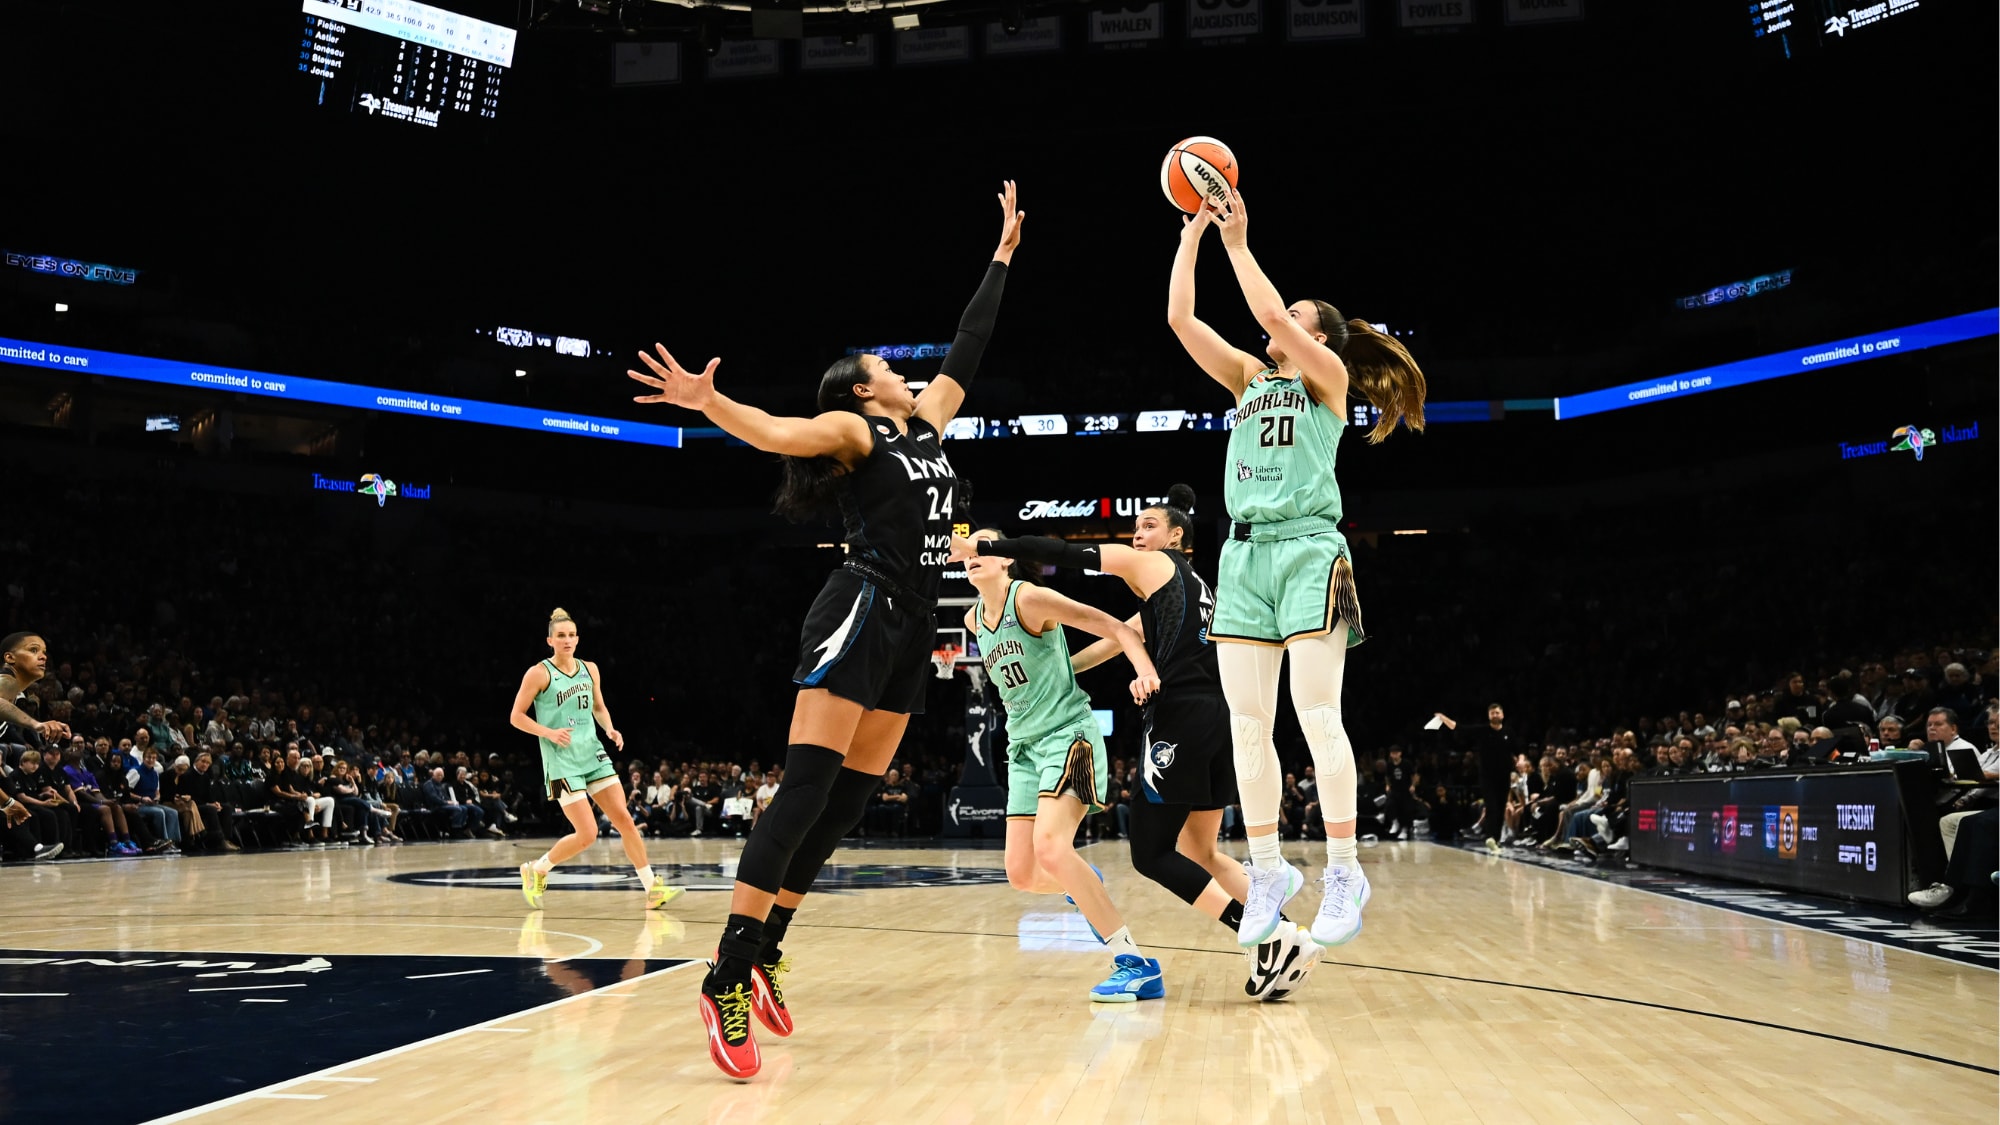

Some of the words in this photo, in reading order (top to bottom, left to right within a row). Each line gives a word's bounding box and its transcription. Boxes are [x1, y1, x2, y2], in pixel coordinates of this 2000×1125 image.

[1192, 13, 1257, 29] AUGUSTUS
[1294, 10, 1358, 27] BRUNSON
[1409, 2, 1463, 18] FOWLES
[1763, 3, 1794, 21] Stewart
[1848, 2, 1887, 23] Treasure
[1101, 18, 1152, 33] WHALEN
[1767, 19, 1792, 33] Jones
[306, 16, 315, 25] 13
[317, 19, 346, 34] Fiebich
[400, 41, 406, 49] 2
[416, 46, 422, 54] 2
[432, 49, 438, 58] 3
[447, 55, 452, 63] 2
[302, 40, 311, 48] 20
[313, 42, 345, 58] Ionescu
[414, 68, 418, 76] 1
[429, 72, 434, 80] 0
[444, 76, 449, 84] 0
[315, 31, 340, 44] Astier
[430, 61, 436, 69] 4
[446, 65, 450, 73] 1
[298, 63, 308, 72] 35
[310, 66, 335, 79] Jones
[409, 90, 415, 99] 2
[425, 94, 431, 103] 3
[440, 98, 446, 106] 2
[300, 51, 310, 60] 30
[312, 53, 342, 69] Stewart
[393, 74, 403, 84] 12
[426, 83, 433, 92] 4
[442, 87, 447, 95] 2
[382, 97, 414, 116] Treasure
[415, 106, 441, 122] Island
[6, 253, 57, 271] EYES
[62, 262, 90, 277] ON
[93, 267, 135, 284] FIVE
[1684, 287, 1725, 309] EYES
[1727, 282, 1751, 299] ON
[1754, 271, 1791, 293] FIVE
[0, 346, 45, 361] mmitted
[49, 352, 61, 363] to
[63, 356, 88, 367] care
[895, 346, 917, 359] ON
[1802, 343, 1860, 366] committed
[1862, 343, 1874, 354] to
[1876, 338, 1900, 351] care
[190, 371, 248, 388] committed
[251, 379, 262, 389] to
[264, 382, 286, 392] care
[1628, 380, 1678, 400] committed
[1679, 380, 1690, 390] to
[1691, 376, 1712, 388] care
[376, 396, 428, 410] committed
[430, 402, 440, 412] to
[441, 404, 462, 415] care
[1235, 391, 1306, 427] ROOKLYN
[542, 417, 589, 431] committed
[591, 423, 600, 433] to
[601, 425, 619, 435] care
[993, 429, 999, 437] 4
[1012, 427, 1018, 435] 4
[1038, 419, 1055, 432] 30
[1151, 415, 1168, 428] 32
[1187, 421, 1194, 429] 4
[1204, 421, 1211, 430] 4
[1084, 416, 1119, 431] 2:39
[1260, 415, 1295, 448] 20
[1838, 441, 1888, 459] Treasure
[1942, 421, 1979, 443] Island
[888, 451, 957, 481] LYNX
[1255, 466, 1283, 475] Liberty
[312, 472, 355, 492] Treasure
[401, 483, 430, 499] Island
[1255, 474, 1283, 482] Mutual
[926, 486, 953, 520] 24
[1018, 499, 1097, 521] Michelob
[1116, 497, 1169, 516] ULT
[1000, 660, 1029, 690] 30
[577, 694, 589, 710] 13
[969, 706, 987, 716] ally
[1837, 804, 1875, 831] TUESDAY
[1838, 845, 1862, 864] ESPN
